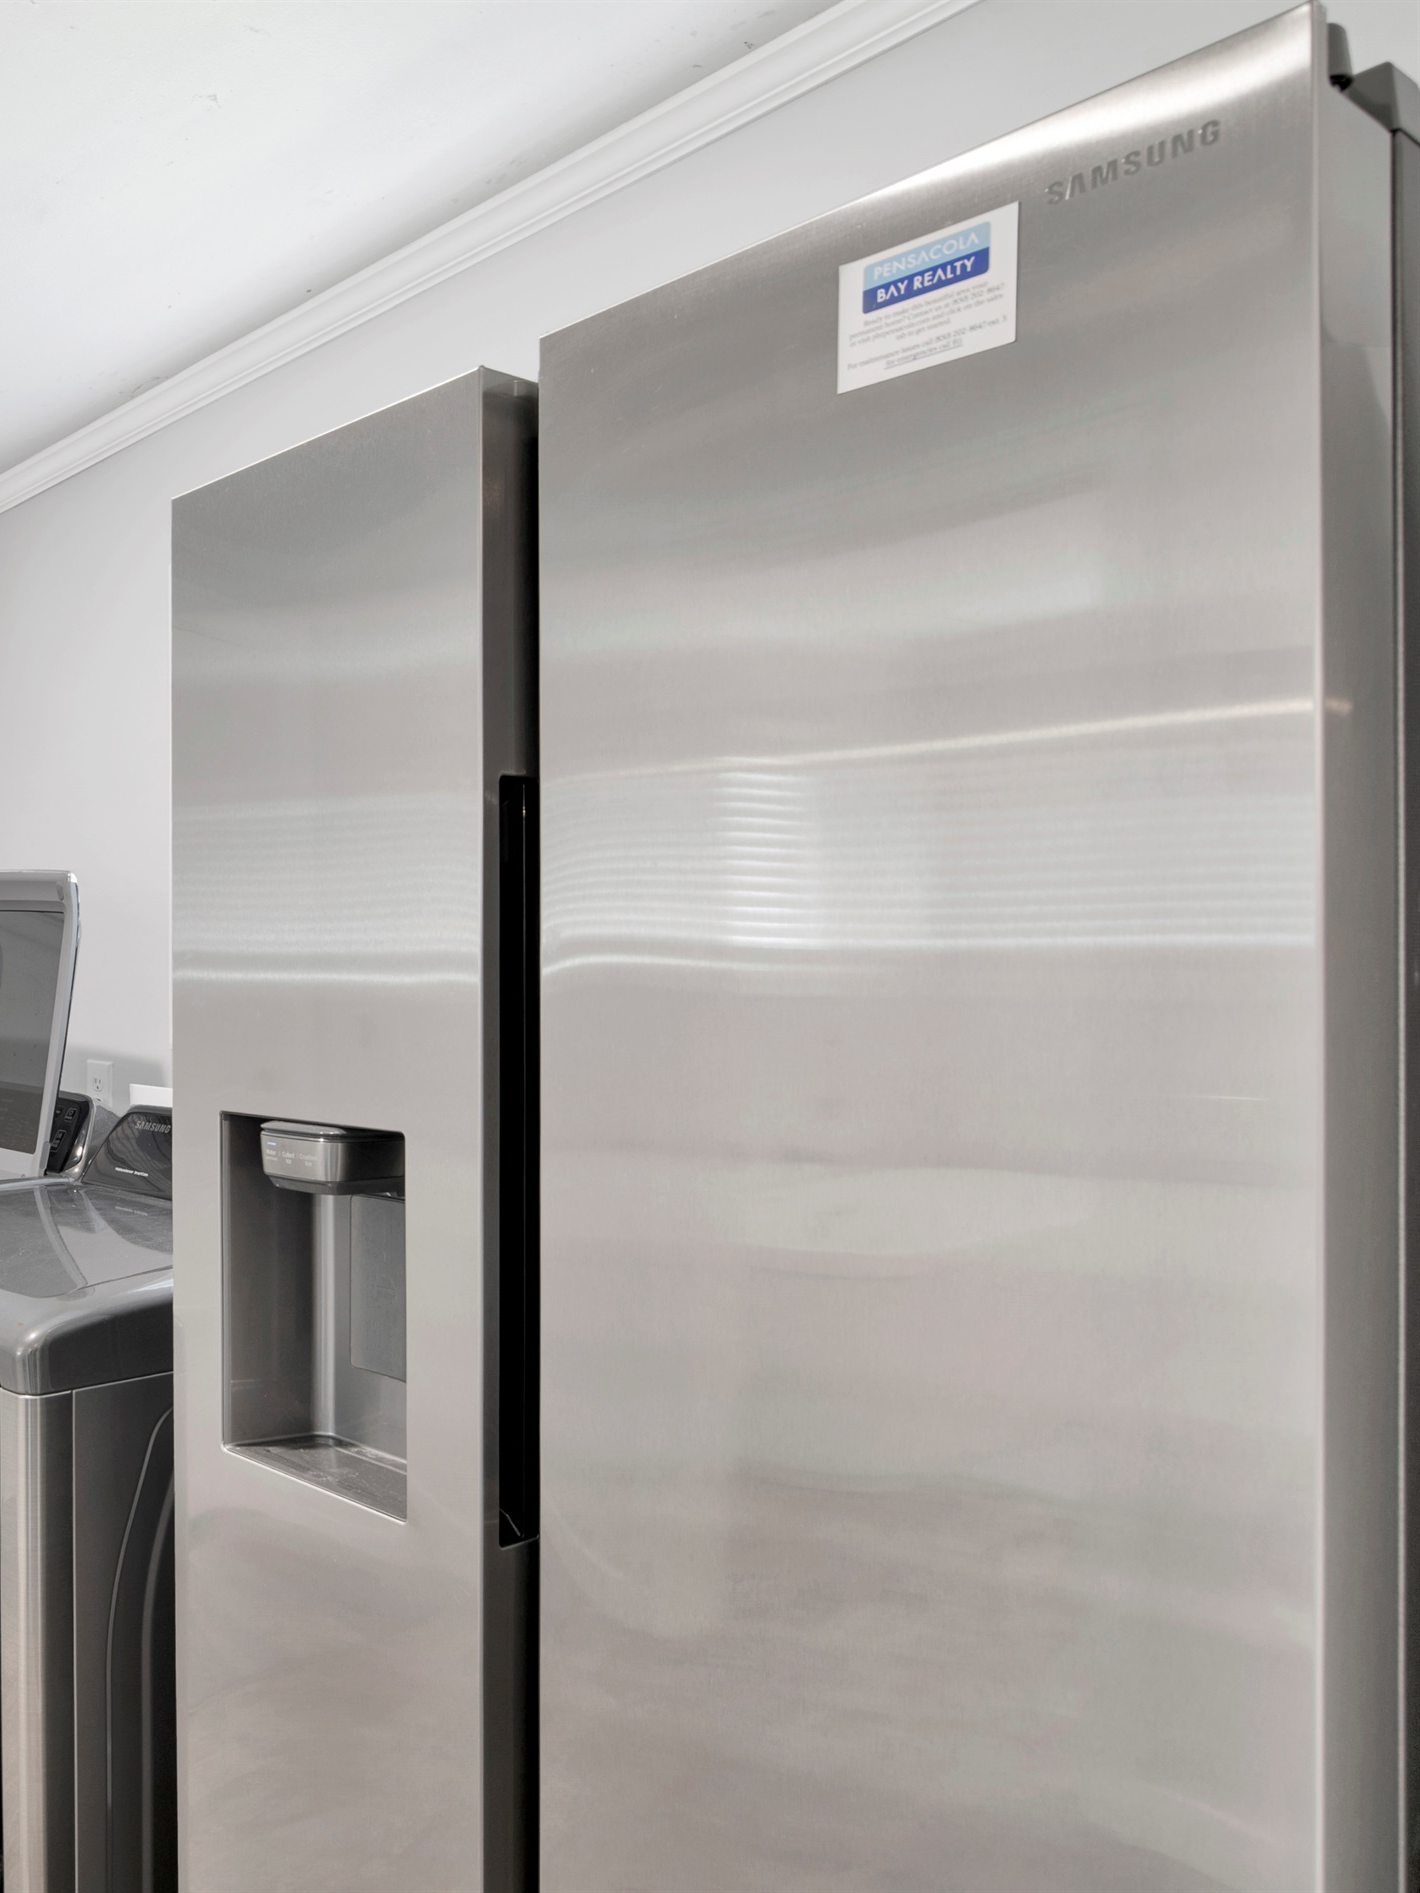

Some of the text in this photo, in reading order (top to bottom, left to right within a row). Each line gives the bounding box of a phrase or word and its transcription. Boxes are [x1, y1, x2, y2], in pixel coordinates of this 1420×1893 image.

[1045, 119, 1221, 205] SAMSUNG
[873, 231, 979, 281] PENSACOLA
[876, 256, 976, 303] BAY REALTY
[134, 1121, 171, 1133] SAMSUNG
